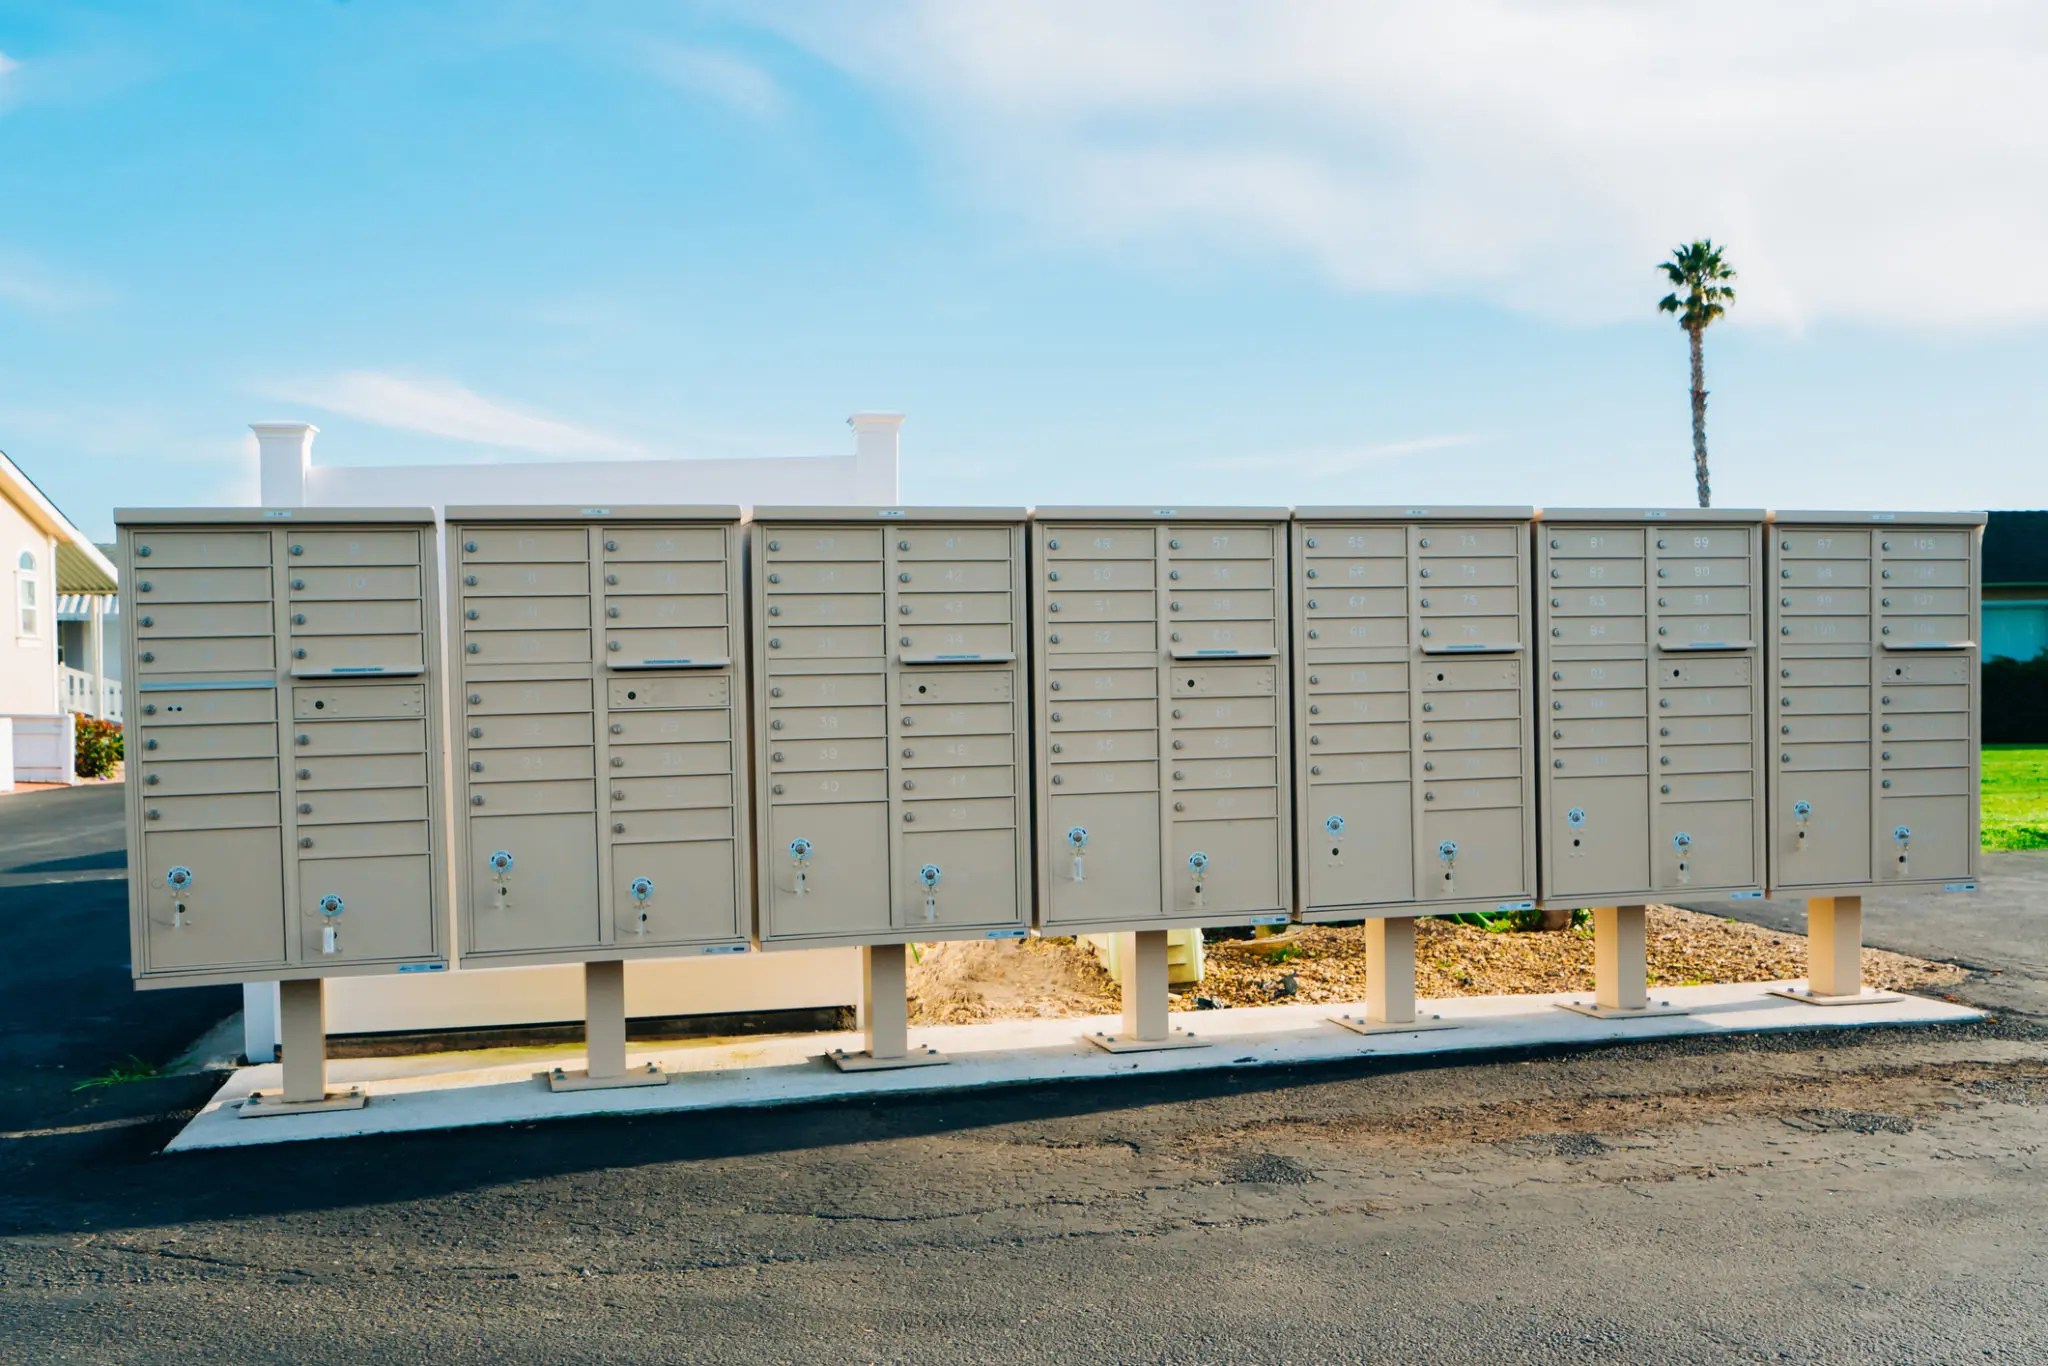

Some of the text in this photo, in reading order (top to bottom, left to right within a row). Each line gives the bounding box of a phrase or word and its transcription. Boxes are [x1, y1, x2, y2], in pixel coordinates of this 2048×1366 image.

[1212, 536, 1229, 548] 57
[1459, 536, 1477, 547] 73
[1590, 537, 1604, 549] 81
[1693, 537, 1709, 548] 89
[1817, 539, 1832, 549] 97
[1913, 539, 1935, 550] 105
[1589, 566, 1605, 578] 82
[1694, 566, 1710, 577] 90
[1348, 595, 1366, 608] 67
[1694, 594, 1710, 605] 91
[1094, 631, 1111, 643] 52
[1590, 625, 1606, 637] 84
[818, 747, 838, 760] 39
[819, 779, 839, 792] 40
